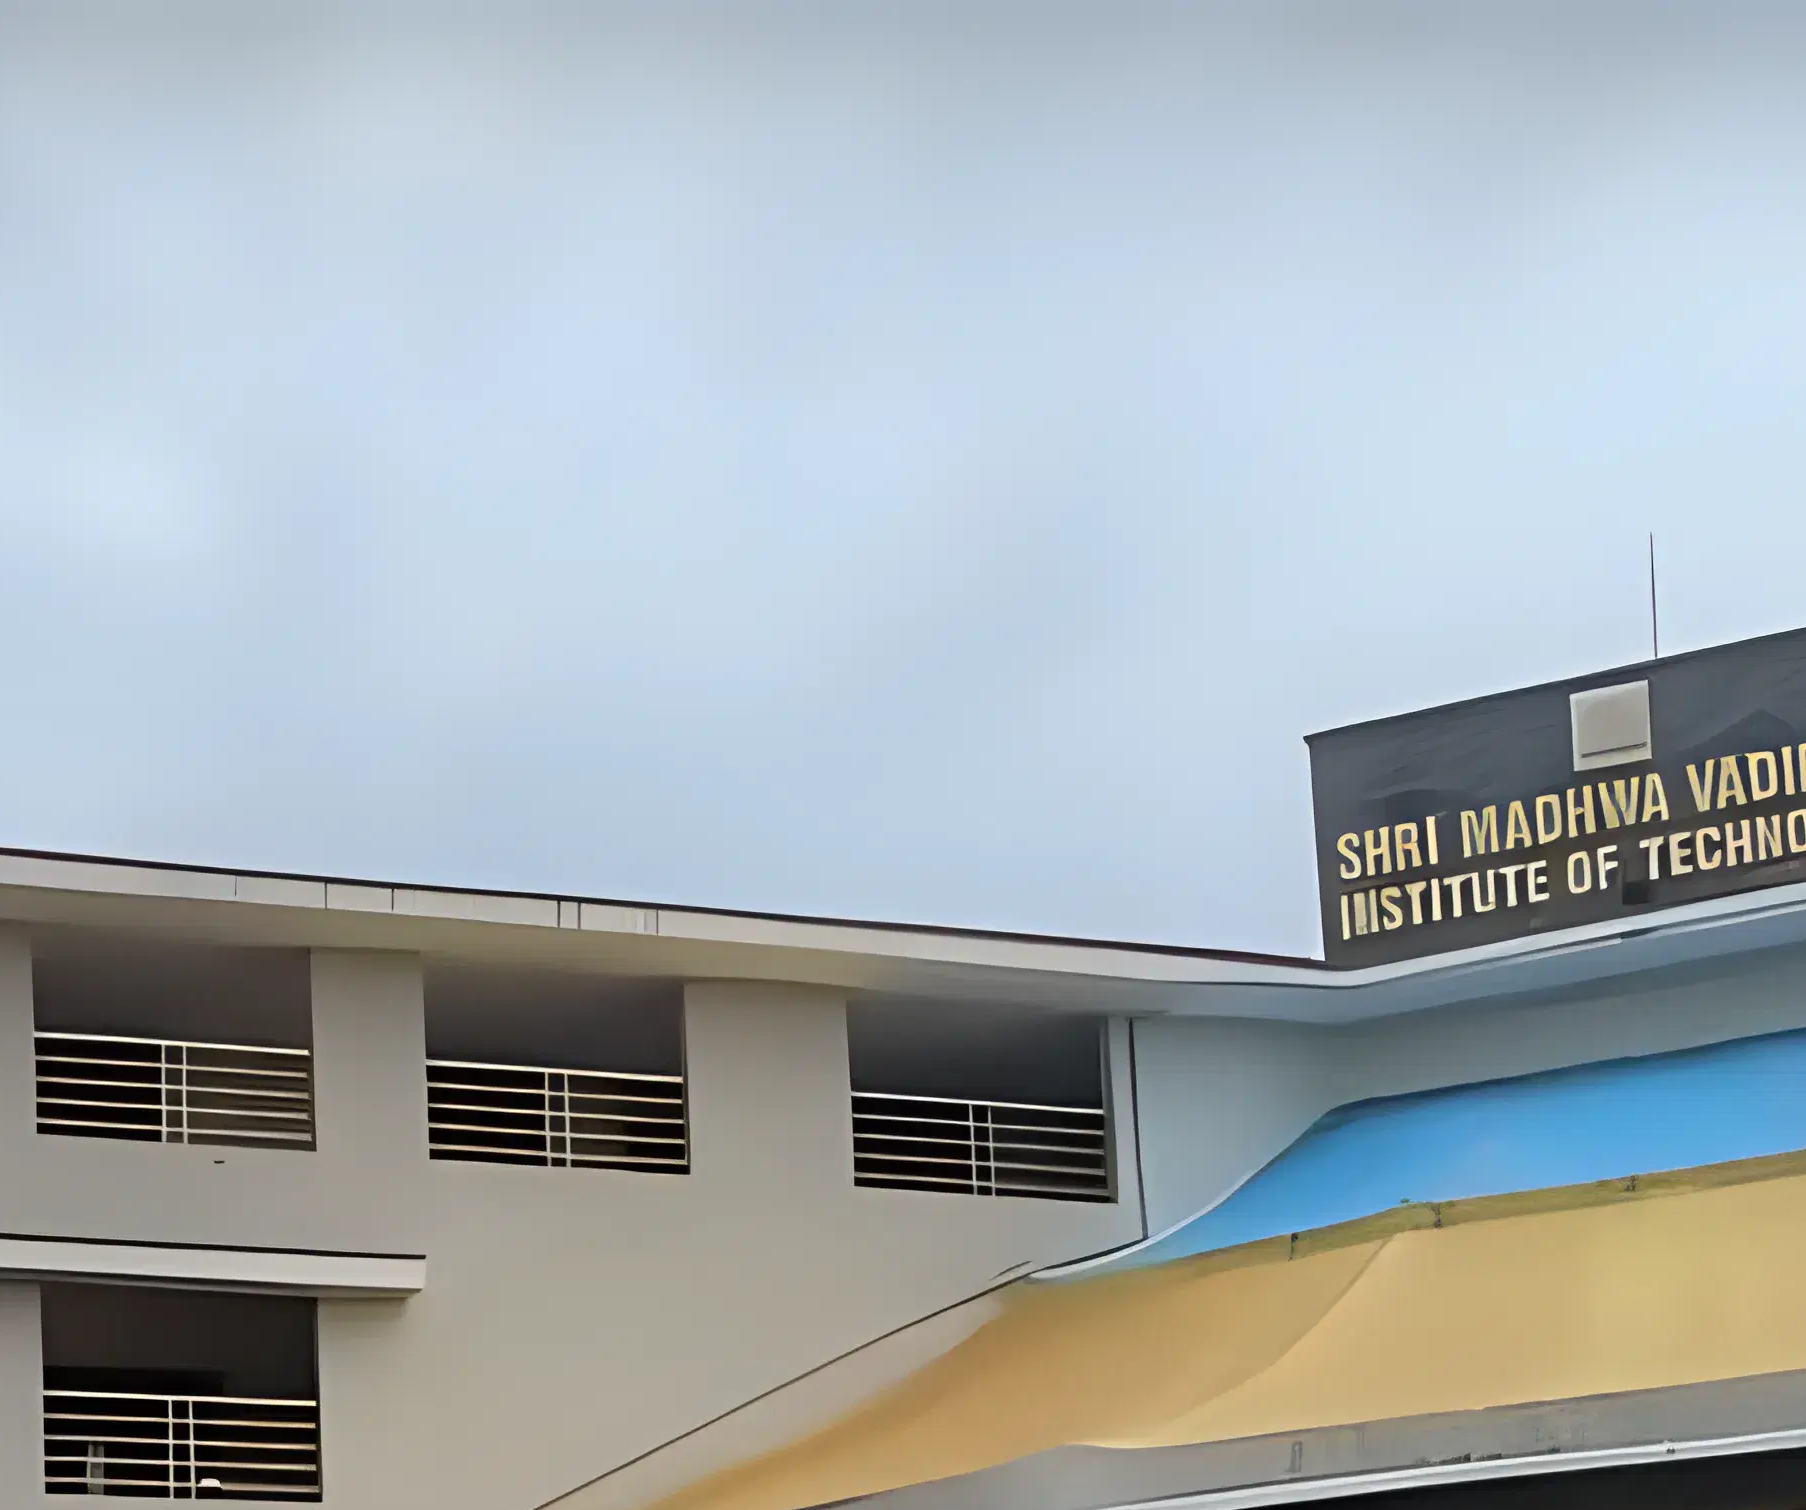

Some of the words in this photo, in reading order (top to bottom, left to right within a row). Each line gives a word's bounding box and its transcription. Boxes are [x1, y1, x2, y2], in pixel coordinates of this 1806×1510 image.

[1336, 815, 1439, 880] SHRI
[1460, 772, 1670, 859] MADHWA
[1340, 859, 1550, 941] INSTITUTE
[1567, 844, 1619, 894] OF
